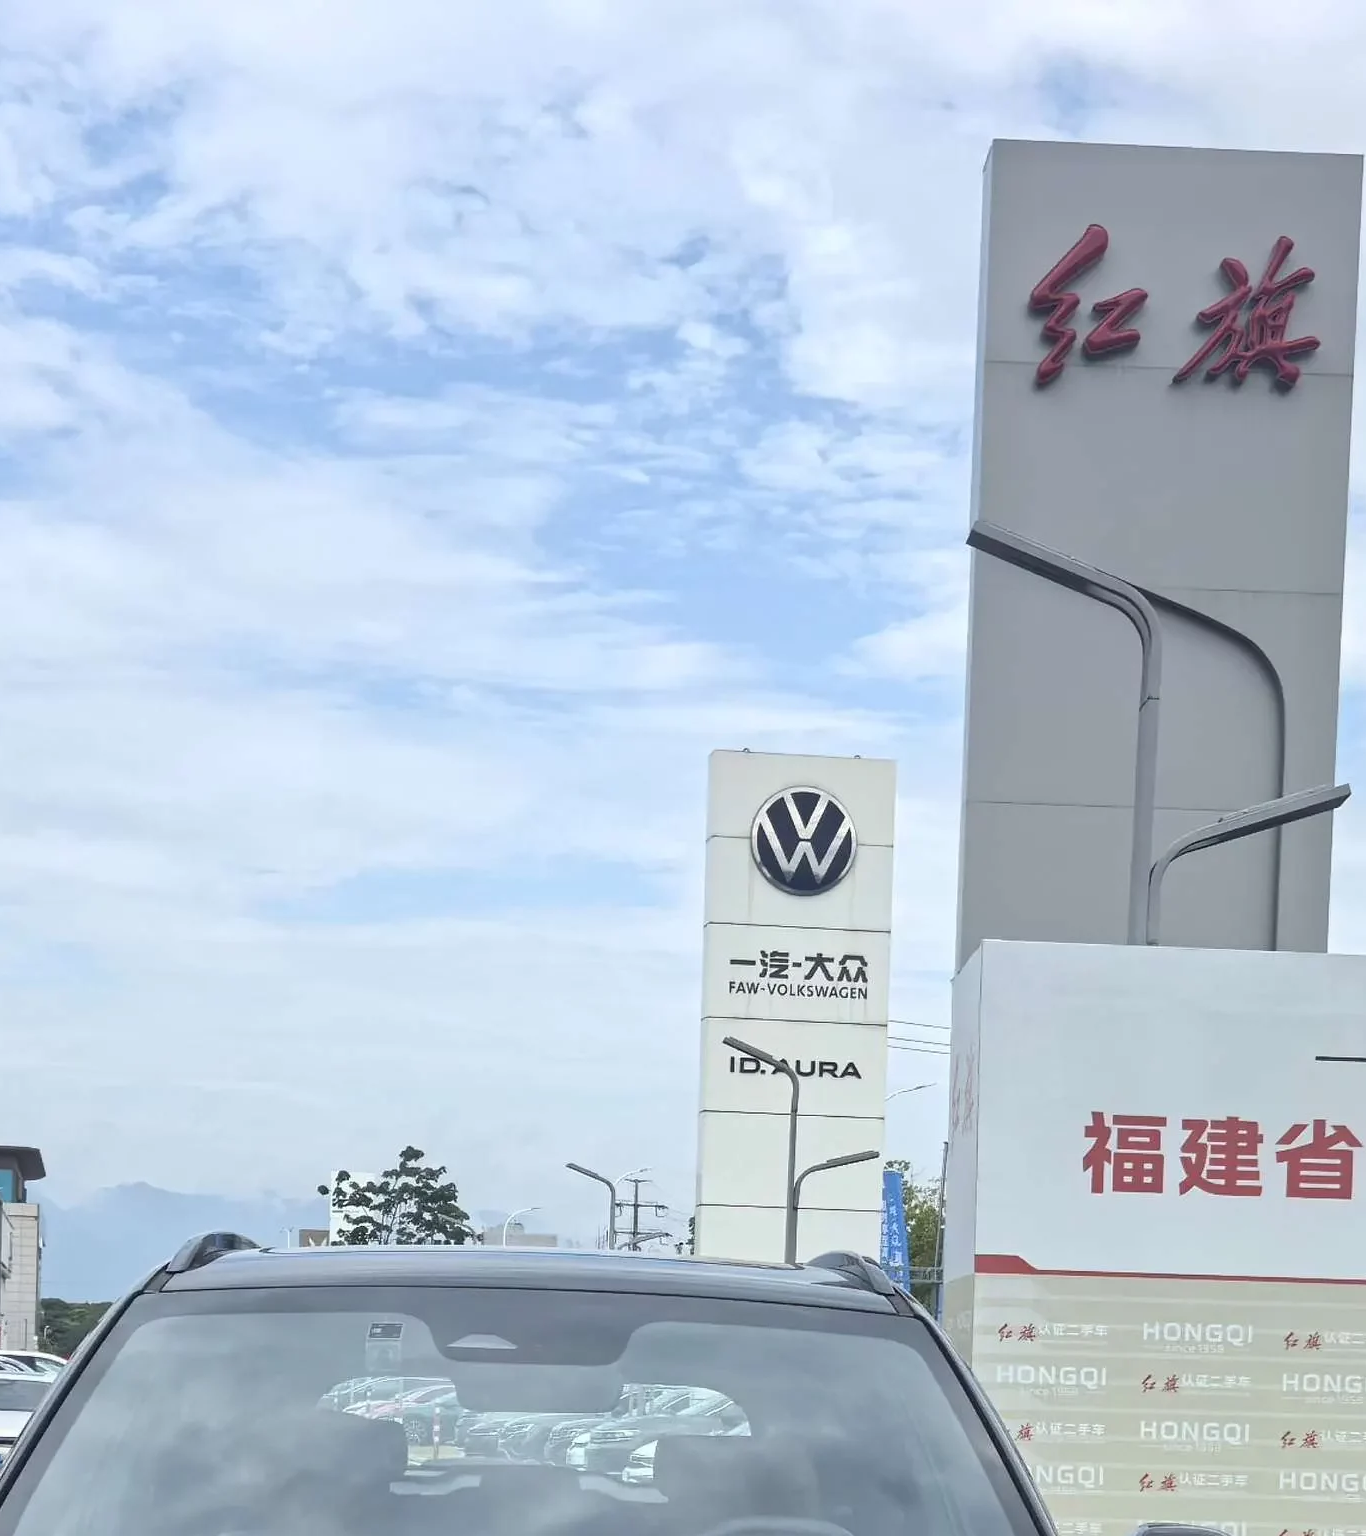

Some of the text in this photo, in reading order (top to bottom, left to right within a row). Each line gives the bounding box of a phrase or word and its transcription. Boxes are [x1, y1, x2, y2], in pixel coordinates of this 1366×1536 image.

[1029, 223, 1321, 387] 红旗
[728, 981, 868, 999] FAW-VOLKSWAGEN
[1143, 1322, 1254, 1346] HONGQI
[996, 1365, 1107, 1389] HONGQI
[1015, 1422, 1107, 1442] 旗认证二手车
[1139, 1420, 1250, 1445] HONGQI
